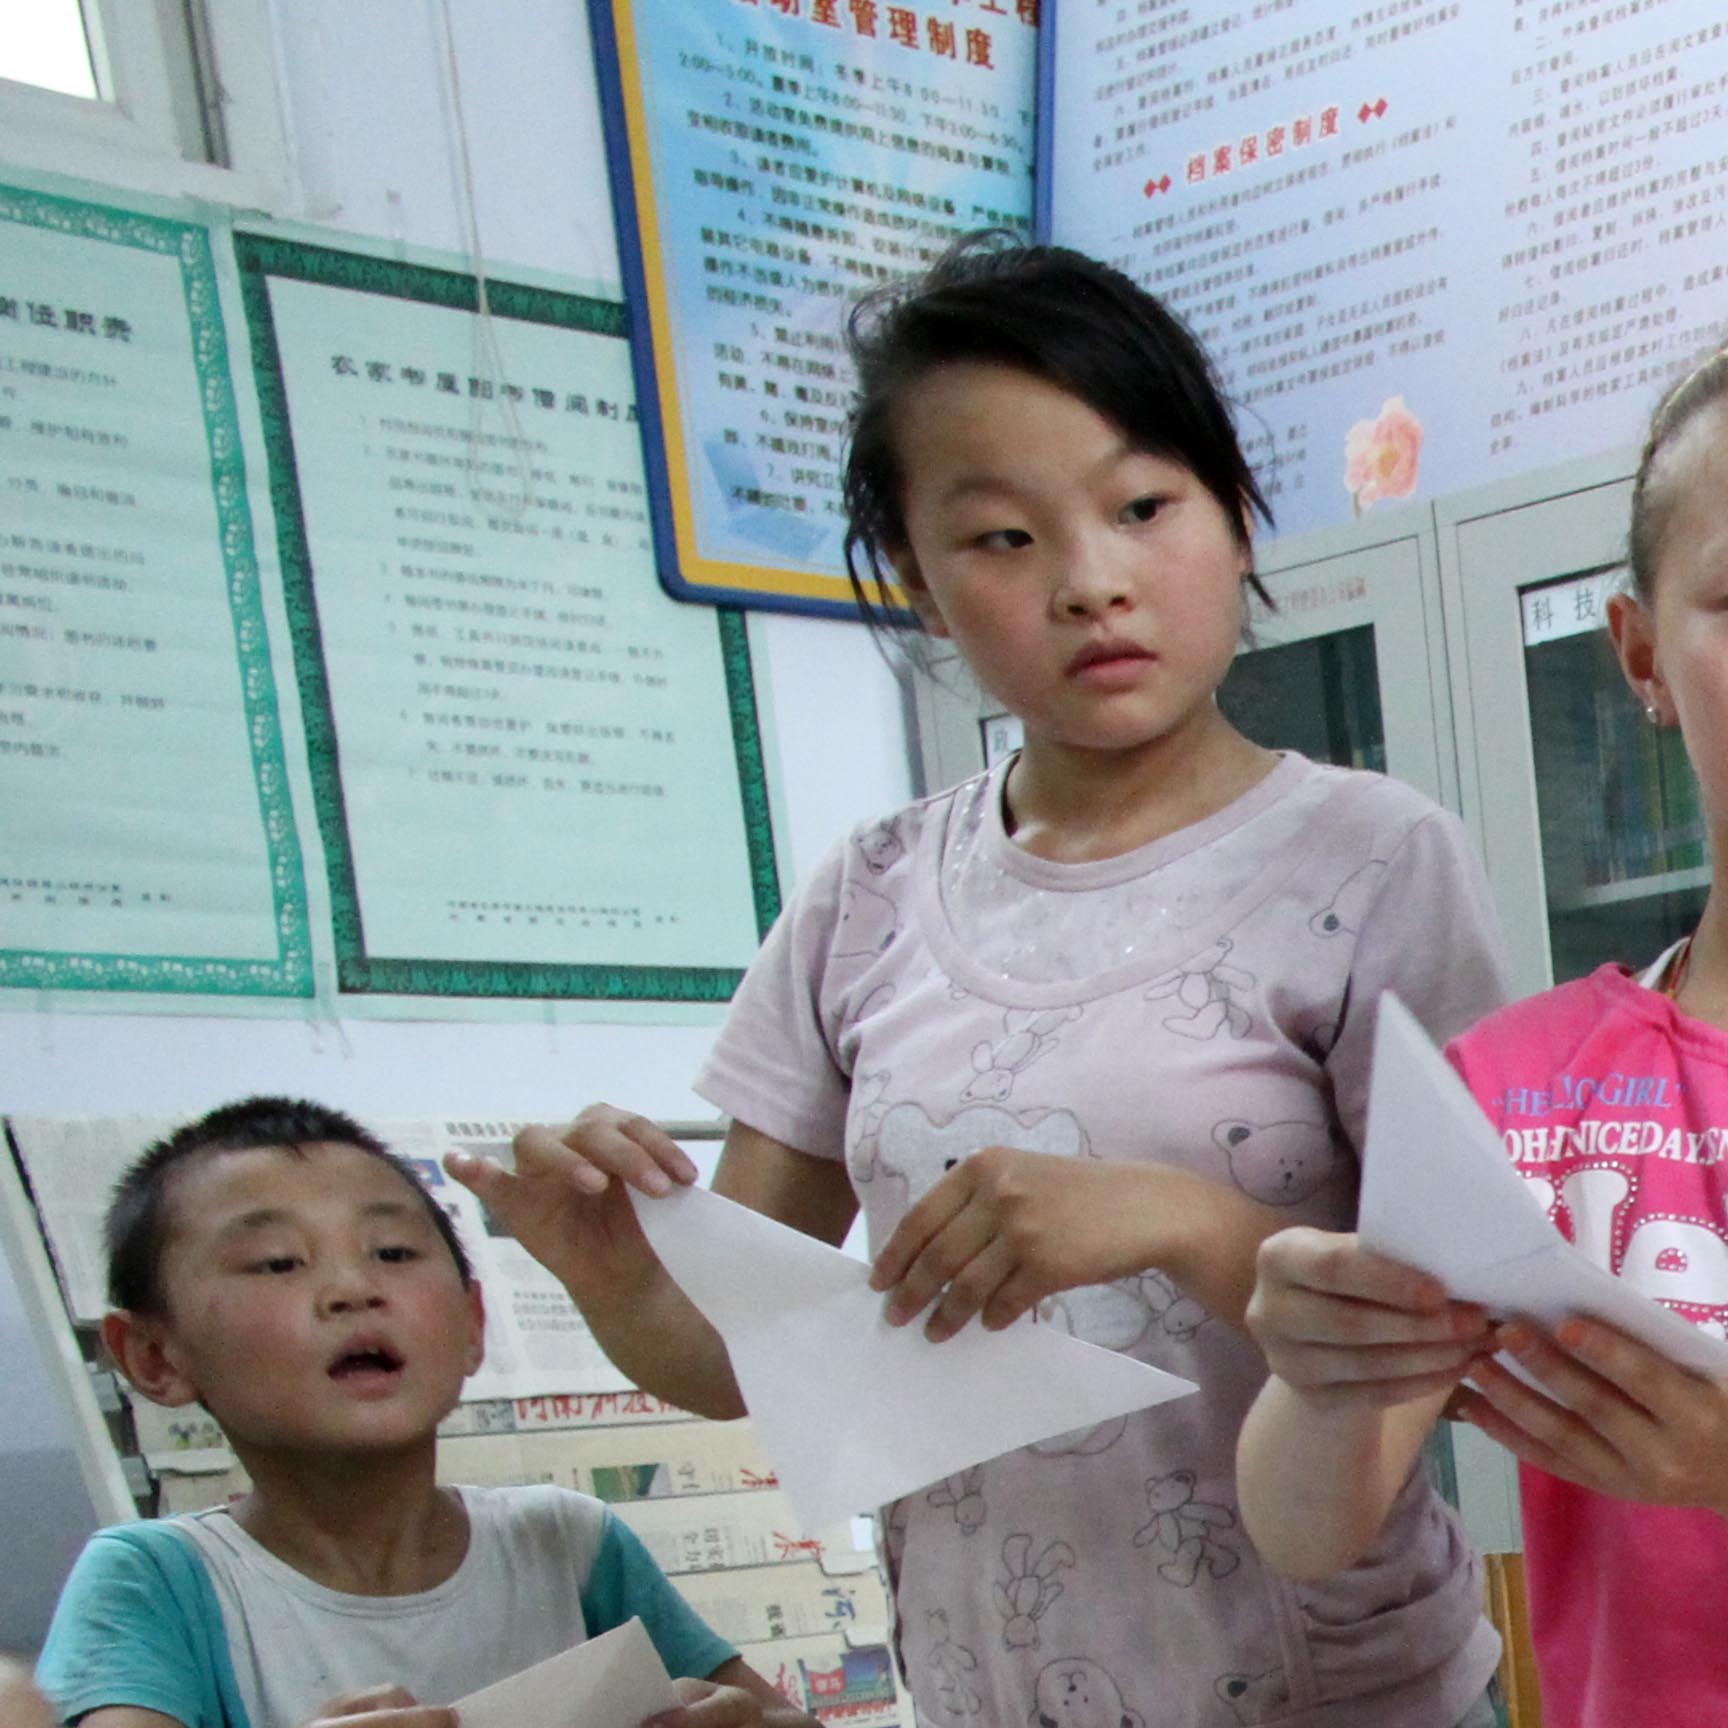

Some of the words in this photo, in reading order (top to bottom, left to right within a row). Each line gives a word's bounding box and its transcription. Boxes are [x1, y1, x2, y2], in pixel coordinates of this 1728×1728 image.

[1184, 104, 1342, 187] 档案保密制度
